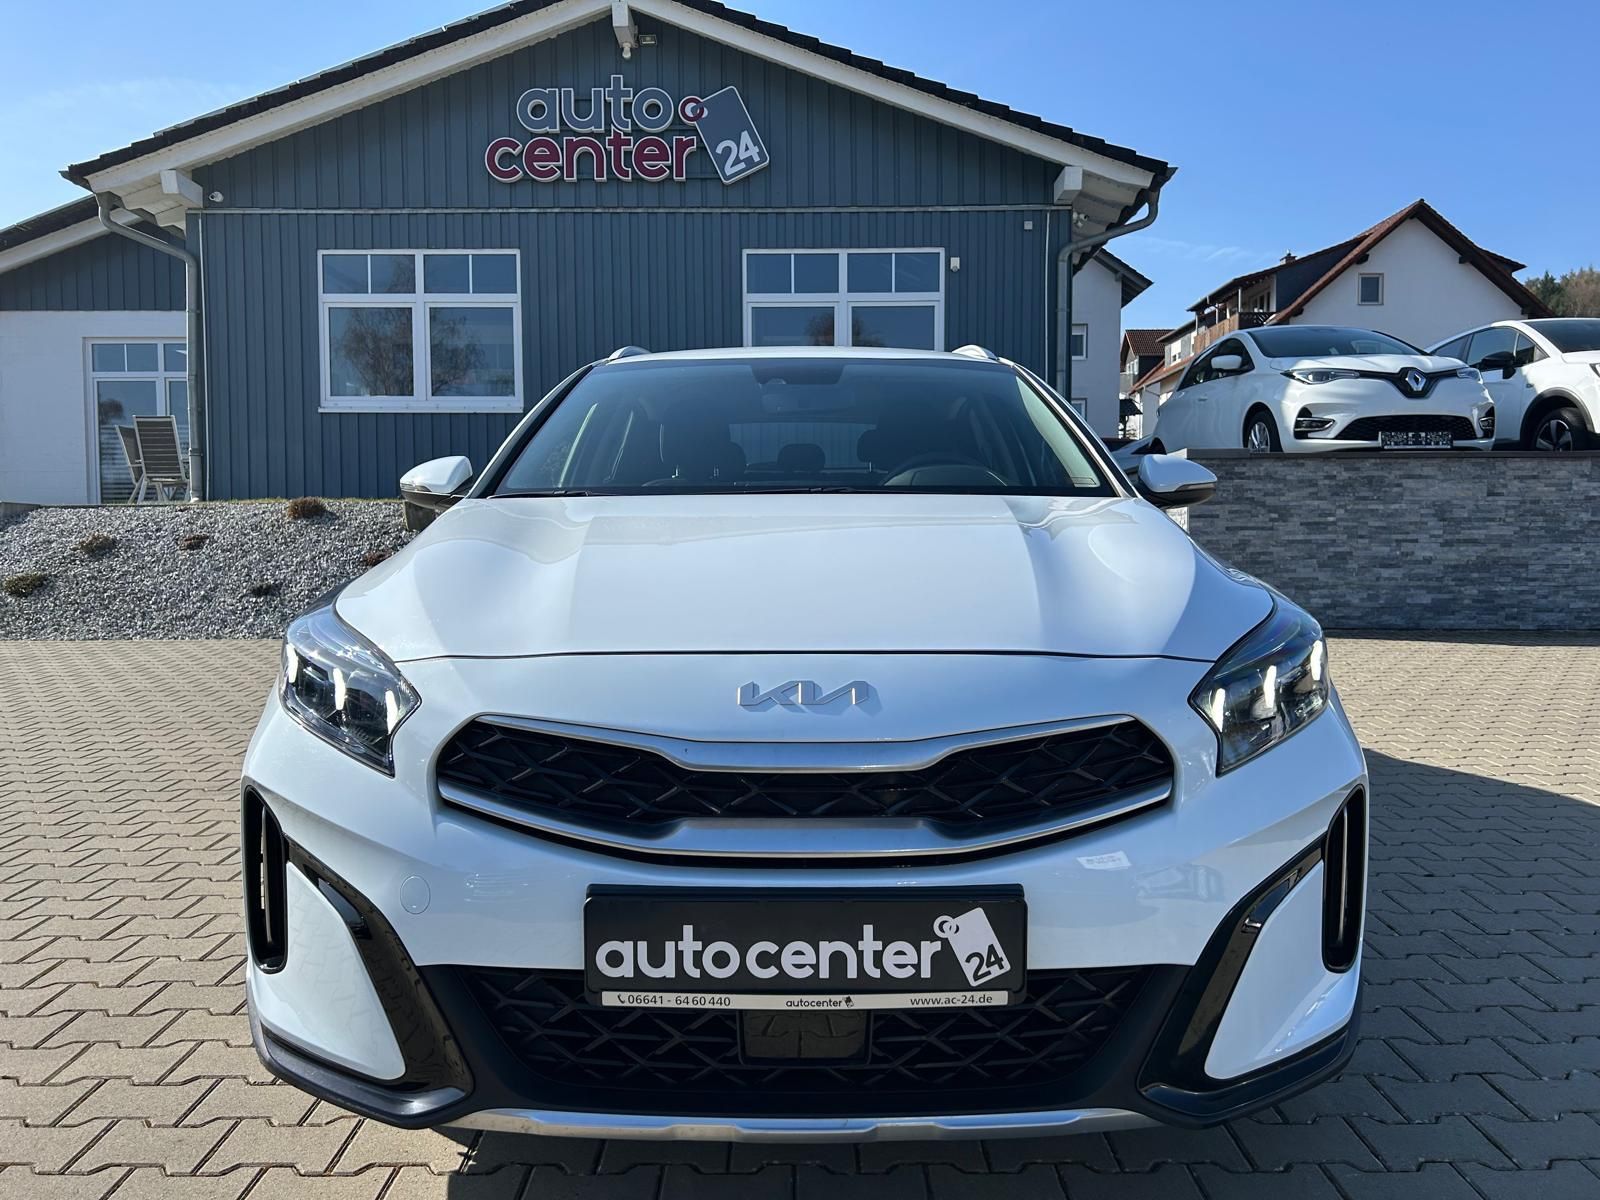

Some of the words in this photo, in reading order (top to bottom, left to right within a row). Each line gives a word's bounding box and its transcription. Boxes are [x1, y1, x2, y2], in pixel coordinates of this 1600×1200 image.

[516, 75, 674, 133] auto
[485, 125, 697, 183] center
[715, 130, 760, 176] 24
[736, 680, 870, 706] KIA
[964, 943, 1005, 983] 24
[785, 996, 842, 1008] autocenter
[909, 993, 993, 1006] www.ac-24.de
